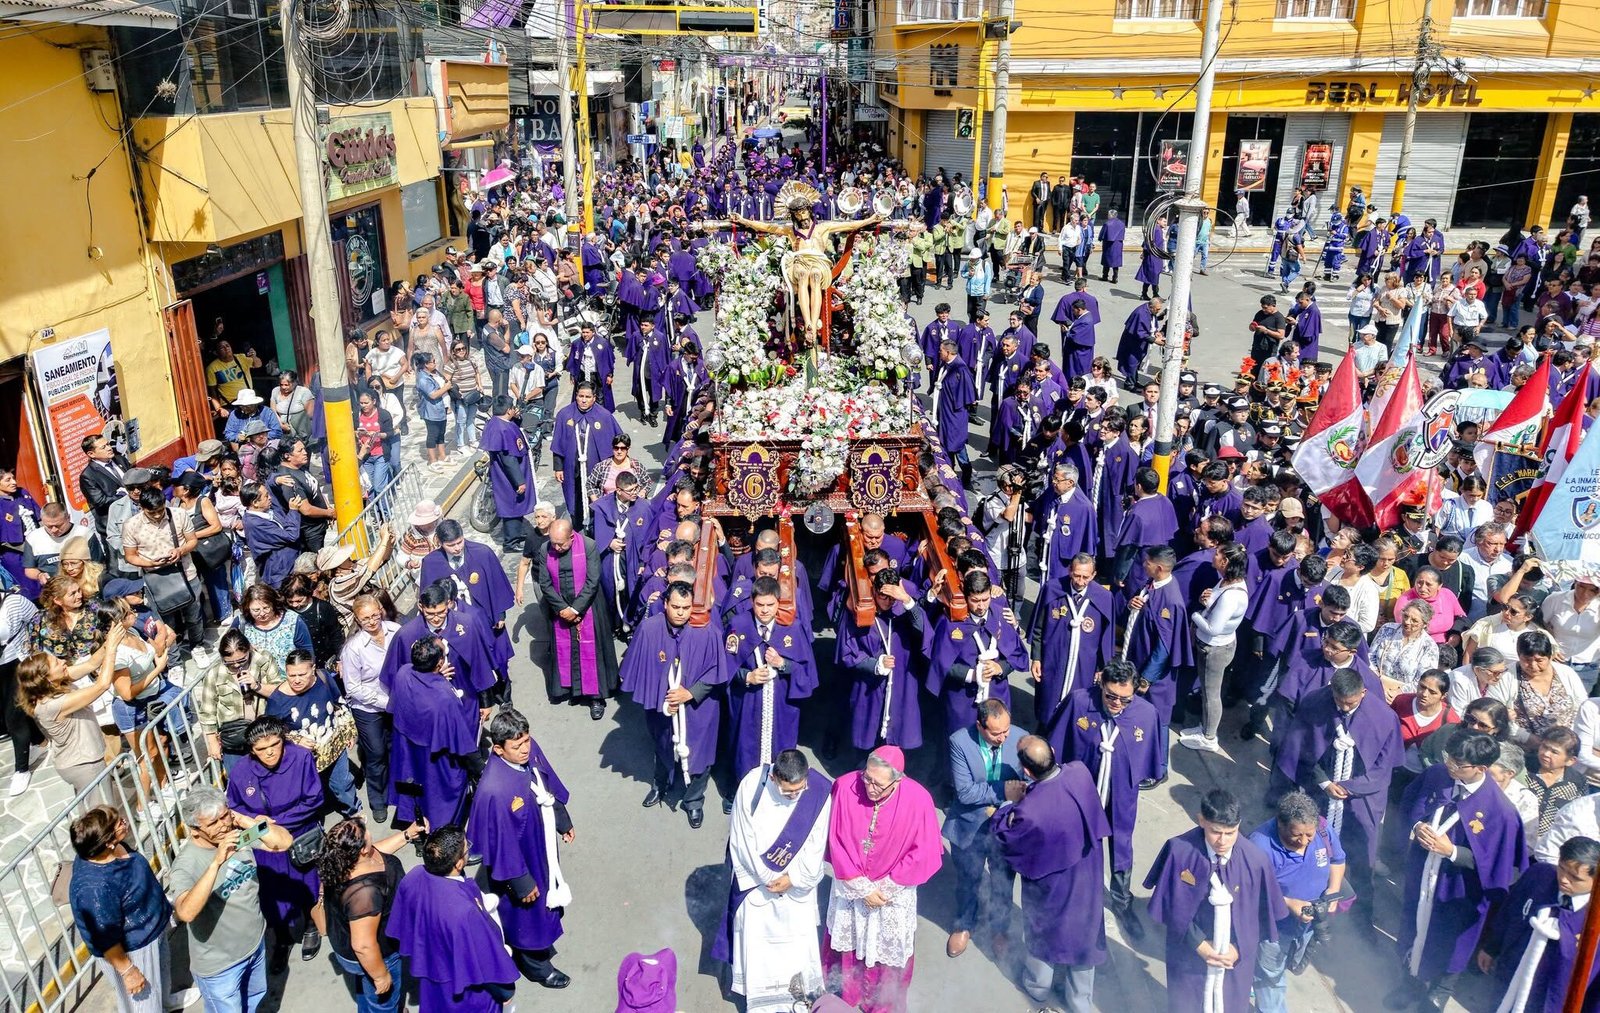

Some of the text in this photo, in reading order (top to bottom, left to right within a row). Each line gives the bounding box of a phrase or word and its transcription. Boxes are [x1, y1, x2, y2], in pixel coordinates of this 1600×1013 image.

[1304, 82, 1482, 106] REAL HOTEL
[44, 355, 97, 382] SANEAMIENTO
[74, 374, 96, 387] PRIVADOS
[747, 475, 762, 498] 6
[870, 476, 885, 498] 6
[1565, 477, 1576, 485] LA
